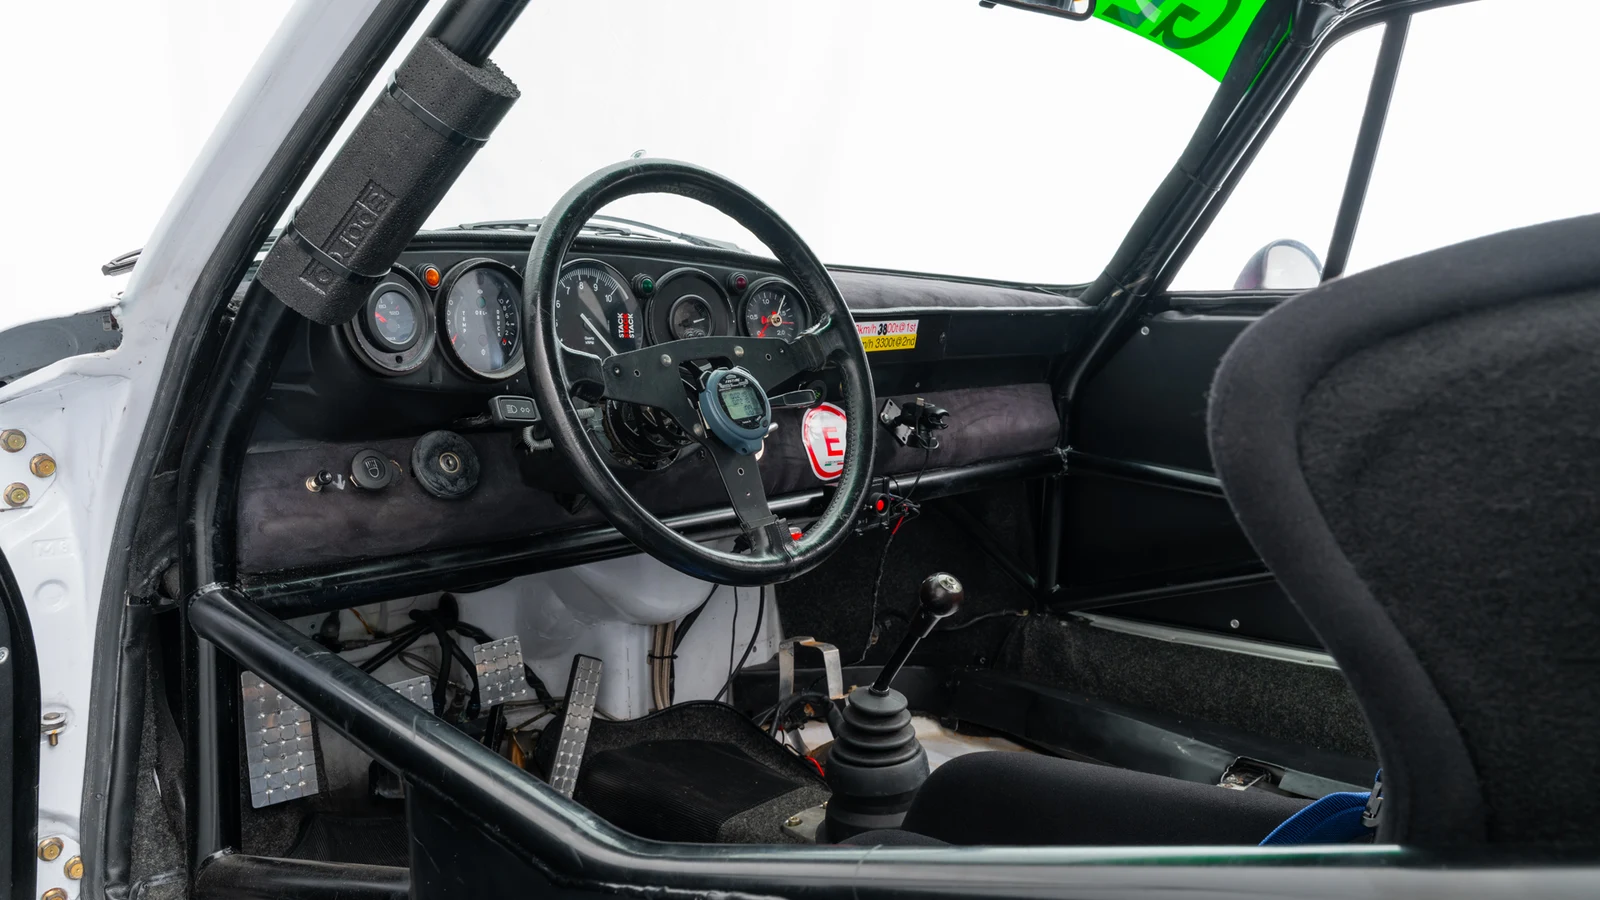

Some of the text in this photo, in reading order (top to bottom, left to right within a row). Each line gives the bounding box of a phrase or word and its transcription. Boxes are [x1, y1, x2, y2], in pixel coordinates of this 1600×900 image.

[579, 282, 584, 290] 8
[593, 284, 598, 292] 9
[566, 286, 571, 295] 7
[605, 294, 612, 302] 10
[556, 300, 561, 308] 6
[822, 426, 843, 456] E
